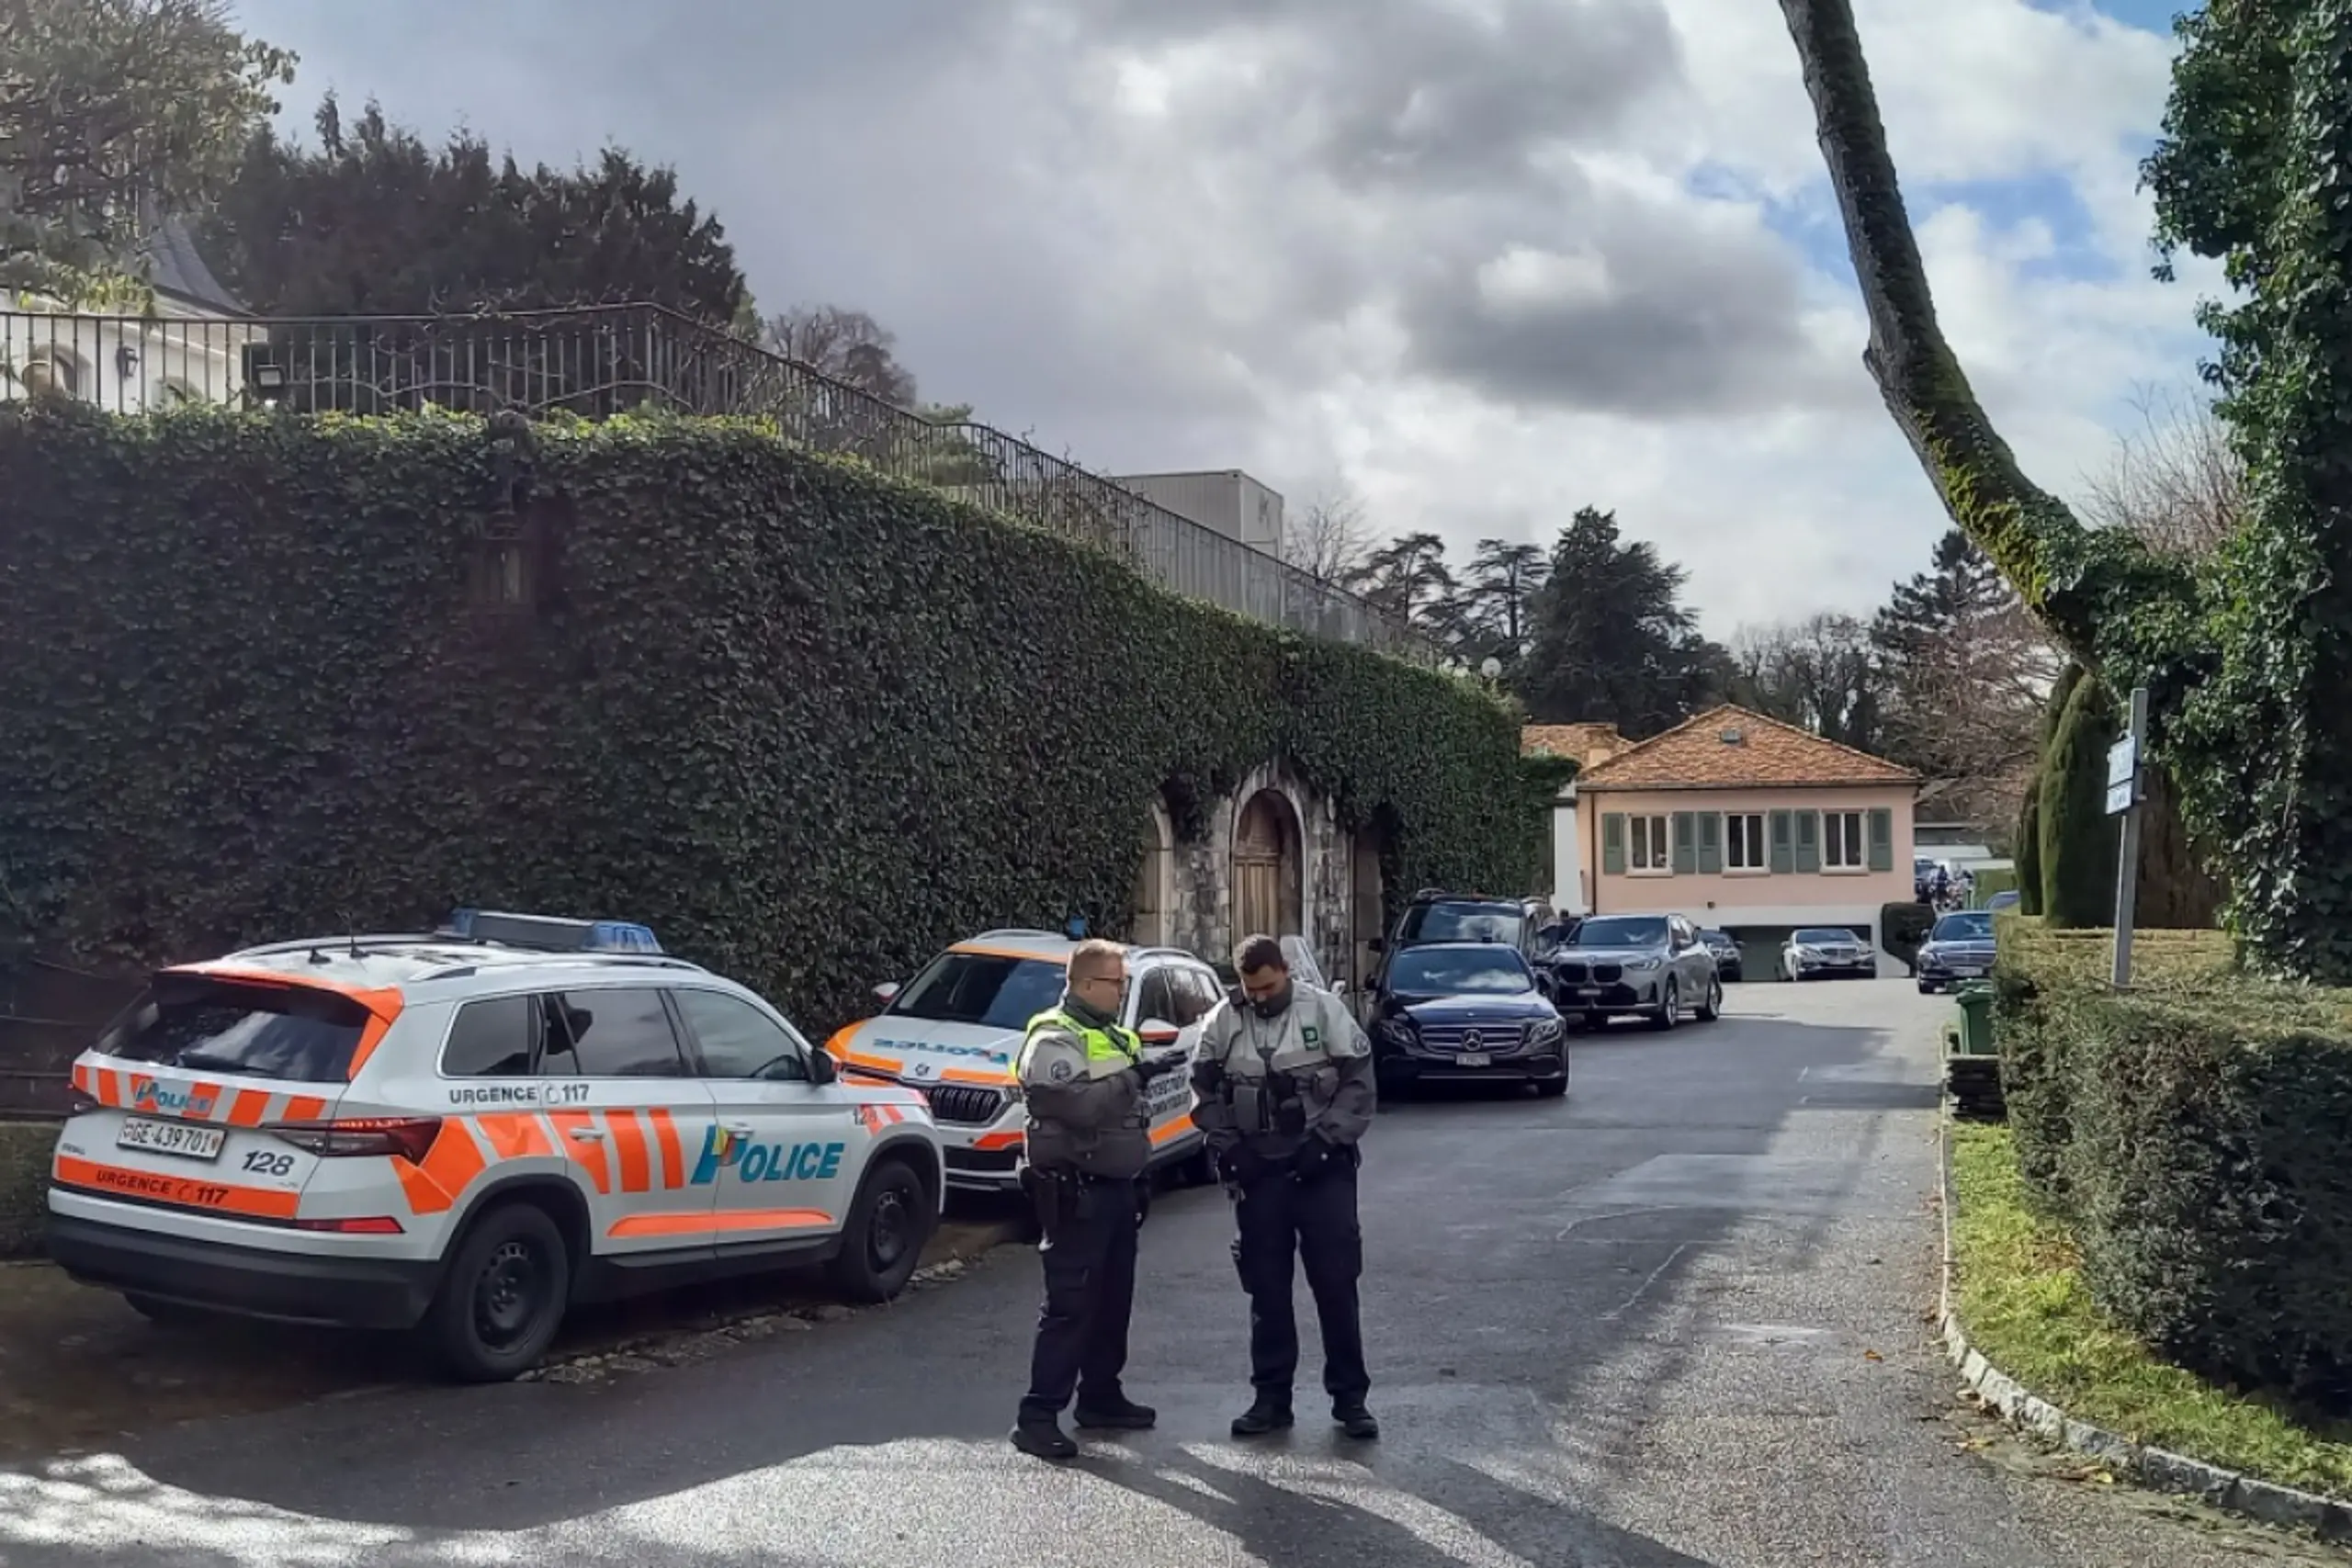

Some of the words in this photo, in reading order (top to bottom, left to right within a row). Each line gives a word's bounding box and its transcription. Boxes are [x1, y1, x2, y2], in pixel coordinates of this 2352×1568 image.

[449, 1087, 537, 1103] URGENCE
[562, 1084, 590, 1101] 117
[242, 1150, 295, 1176] 128
[690, 1124, 845, 1184] POLICE
[96, 1169, 174, 1194] URGENCE
[197, 1186, 229, 1203] 117
